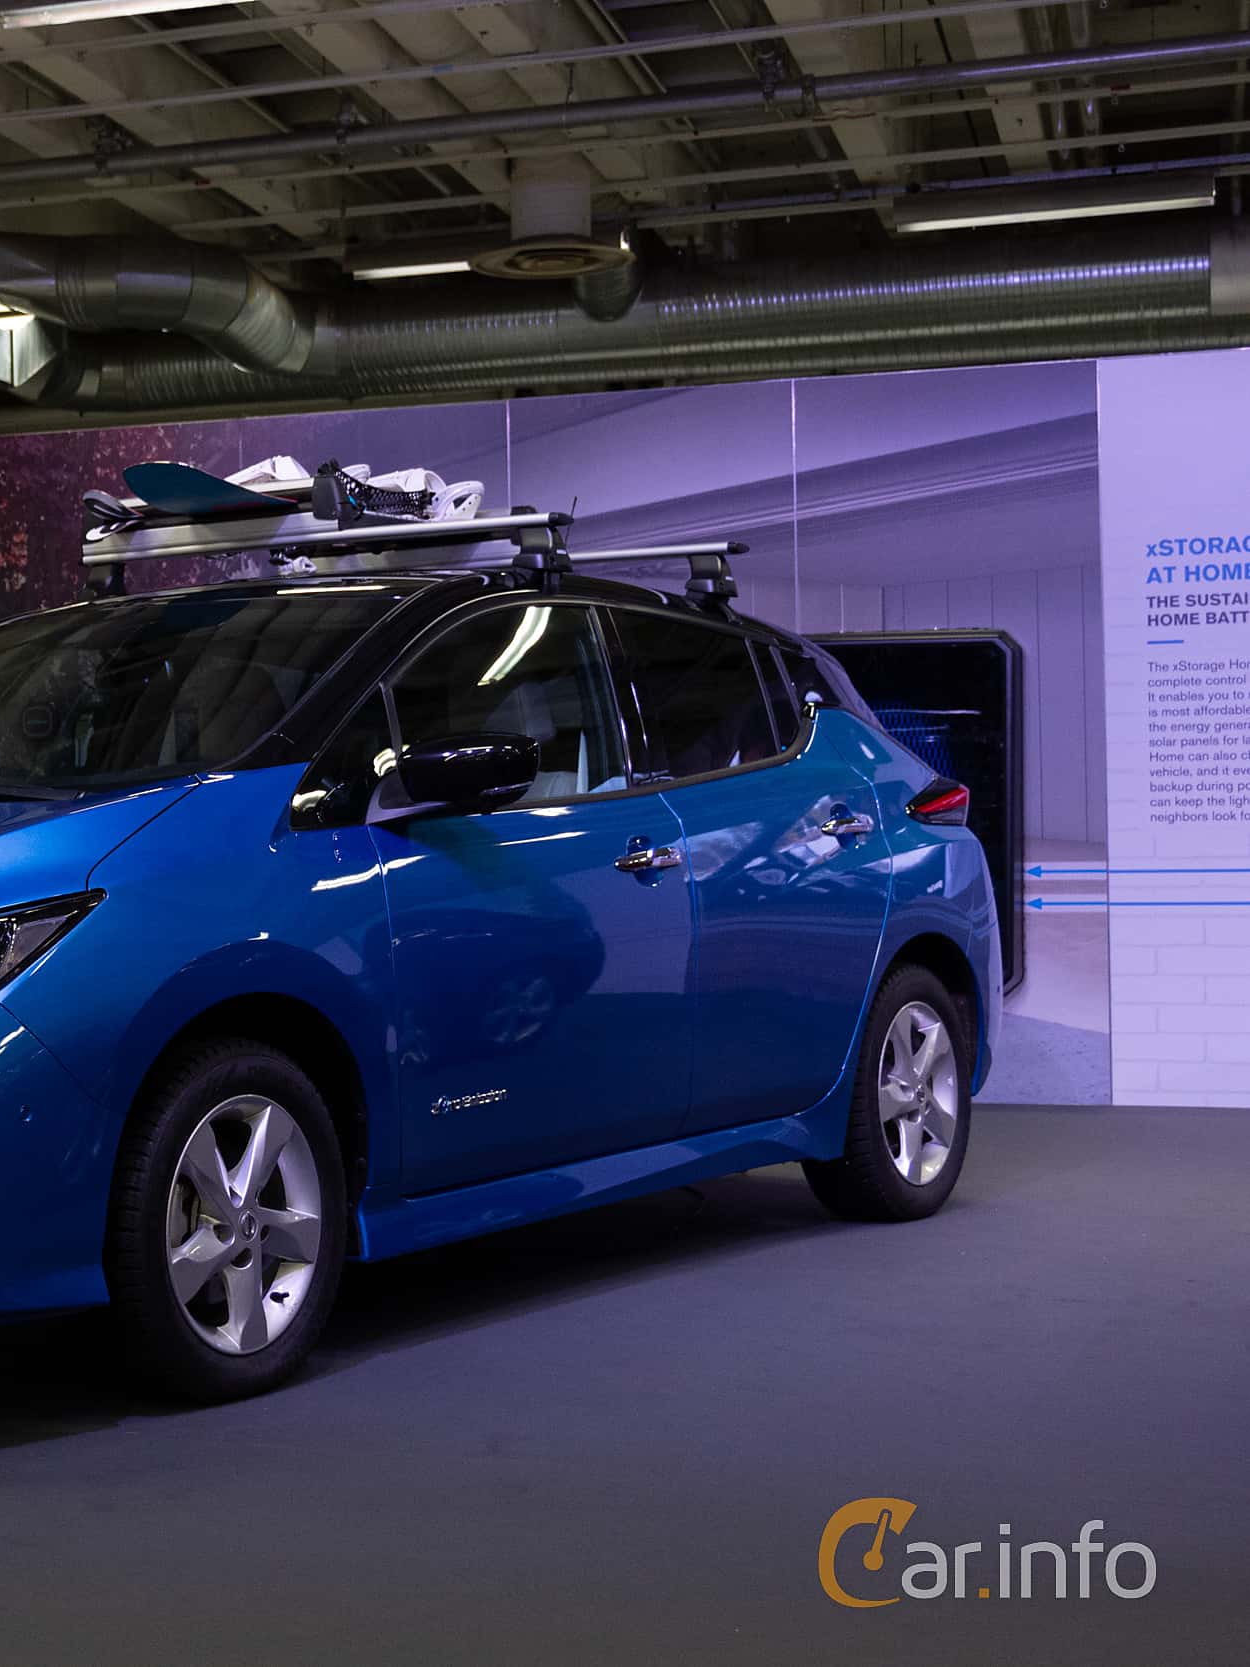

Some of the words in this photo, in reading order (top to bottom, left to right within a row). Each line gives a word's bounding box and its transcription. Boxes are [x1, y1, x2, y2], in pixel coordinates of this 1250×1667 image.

[1146, 566, 1176, 584] AT
[1146, 595, 1180, 608] THE
[1147, 612, 1200, 626] HOME
[1147, 661, 1169, 672] The
[1173, 660, 1225, 672] xStorage
[1148, 675, 1202, 688] complete
[1205, 674, 1246, 685] control
[1148, 692, 1155, 702] It
[1159, 691, 1204, 702] enables
[1208, 692, 1229, 703] you
[1233, 690, 1245, 700] to
[1149, 709, 1158, 717] is
[1161, 707, 1190, 717] most
[1149, 722, 1166, 732] the
[1171, 722, 1210, 733] energy
[1150, 737, 1176, 747] solar
[1180, 735, 1219, 748] panels
[1223, 735, 1238, 745] for
[1150, 752, 1184, 762] Home
[1188, 753, 1209, 761] can
[1213, 750, 1237, 760] also
[1150, 766, 1192, 777] vehicle,
[1197, 765, 1218, 776] and
[1222, 765, 1229, 775] it
[1150, 781, 1192, 793] backup
[1196, 780, 1233, 793] during
[1150, 799, 1171, 807] can
[1175, 796, 1203, 808] keep
[1207, 794, 1225, 806] the
[1150, 811, 1208, 824] neighbors
[1212, 810, 1236, 821] look
